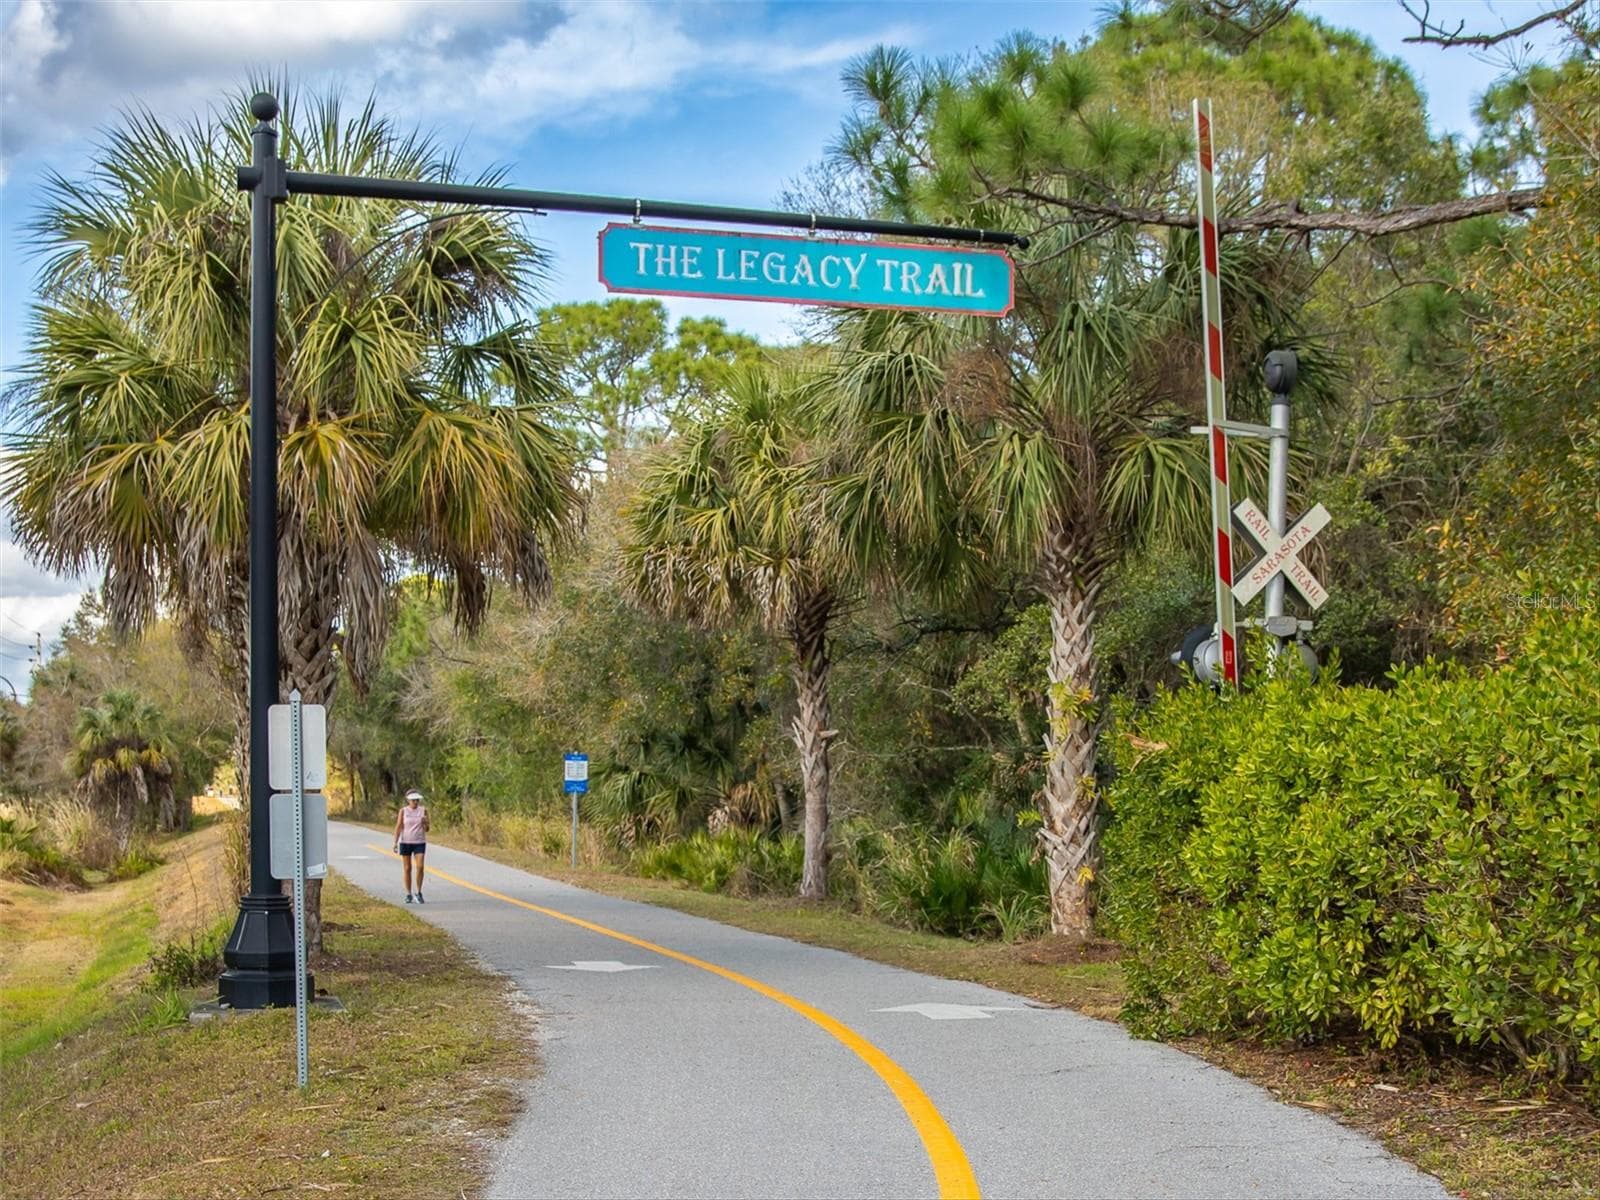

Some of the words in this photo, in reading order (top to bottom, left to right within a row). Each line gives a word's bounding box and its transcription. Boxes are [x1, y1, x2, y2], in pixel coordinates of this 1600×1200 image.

[629, 242, 703, 279] THE
[715, 248, 869, 290] LEGACY
[876, 259, 986, 298] TRAIL
[1244, 509, 1271, 541] RAIL
[1290, 563, 1321, 602] TRAIL
[1252, 525, 1312, 585] SARASOTA
